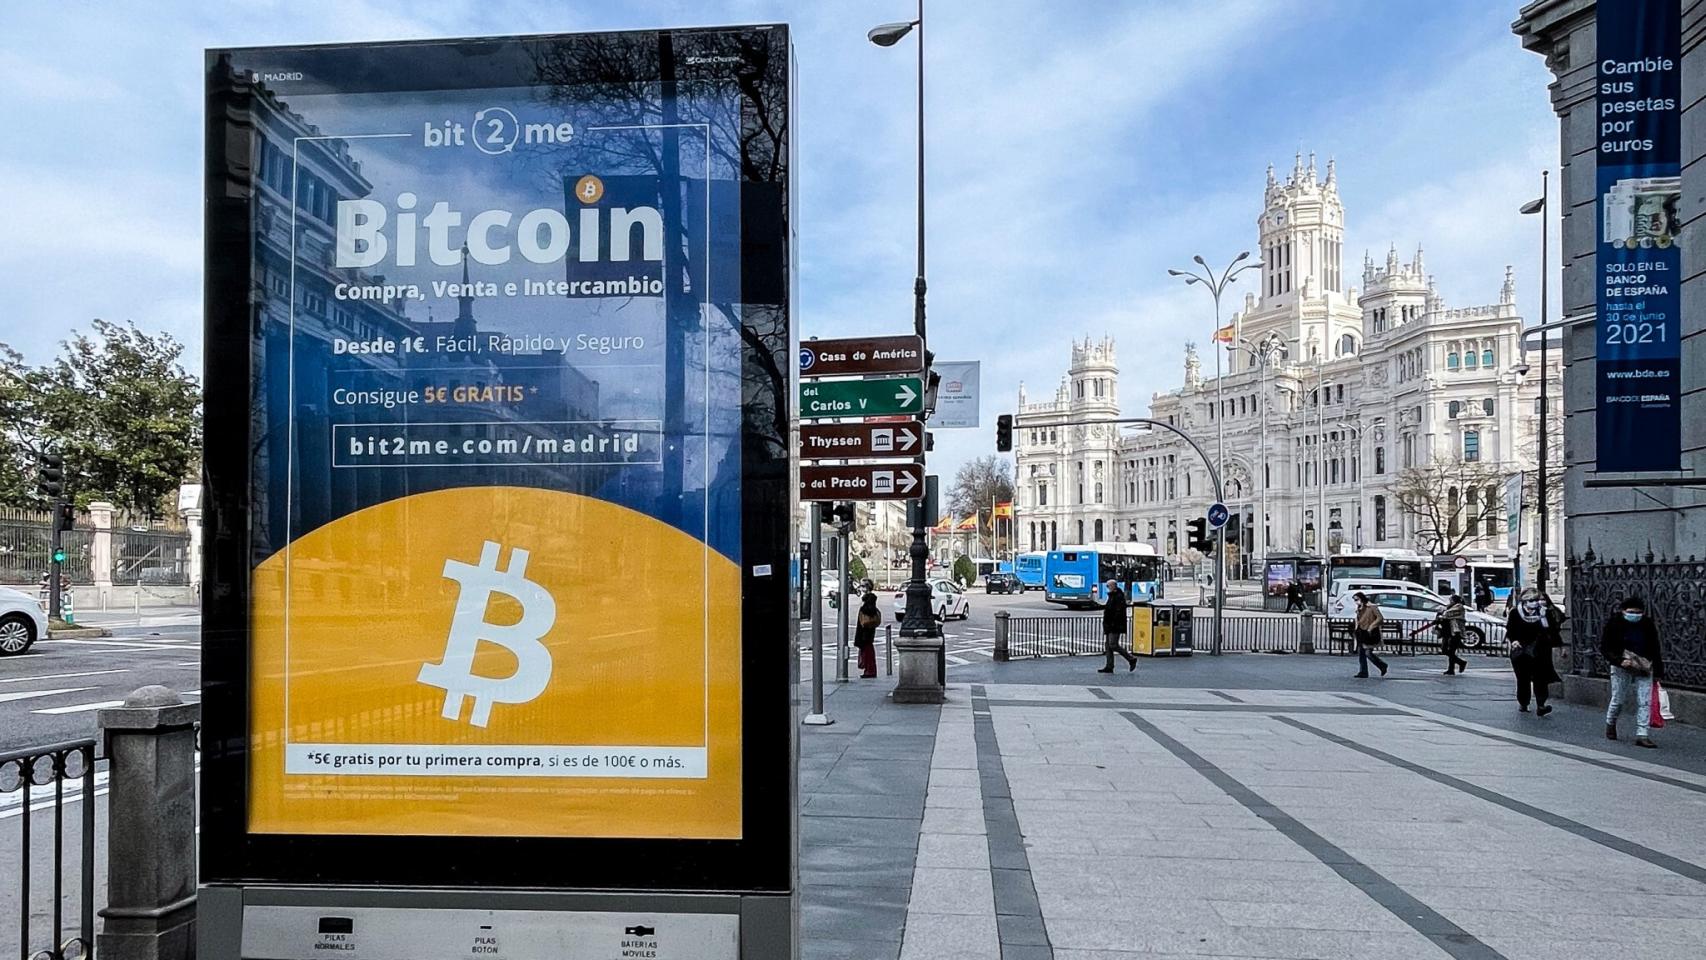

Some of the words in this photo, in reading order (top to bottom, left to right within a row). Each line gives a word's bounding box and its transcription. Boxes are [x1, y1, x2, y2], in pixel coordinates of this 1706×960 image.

[1601, 56, 1673, 75] Cambie
[264, 72, 303, 81] MADRID
[1601, 81, 1634, 94] sus
[1601, 97, 1675, 117] pesetas
[1601, 120, 1635, 136] por
[1601, 138, 1653, 153] euros
[336, 176, 663, 268] Bitcoin
[1606, 263, 1635, 272] SOLO
[1638, 262, 1654, 271] EN
[1655, 261, 1669, 271] EL
[1606, 274, 1647, 285] BANCO
[334, 283, 425, 304] Compra,
[432, 280, 498, 298] Venta
[504, 284, 517, 297] e
[524, 276, 663, 297] Intercambio
[1606, 287, 1622, 297] DE
[1624, 284, 1668, 296] ESPAÑA
[1606, 303, 1634, 311] hasta
[1635, 301, 1645, 310] el
[1606, 312, 1620, 322] 30
[1622, 312, 1636, 321] de
[1639, 312, 1666, 323] junio
[1606, 322, 1666, 344] 2021
[334, 337, 396, 354] Desde
[401, 337, 430, 354] 1€.
[436, 335, 481, 355] Fácil,
[489, 334, 557, 356] Rápido
[559, 337, 571, 355] y
[576, 334, 644, 355] Seguro
[819, 352, 846, 362] Casa
[852, 351, 866, 361] de
[872, 349, 917, 360] América
[1607, 369, 1670, 379] www.bde.es
[334, 387, 419, 409] Consigue
[424, 387, 447, 403] 5€
[453, 386, 524, 403] GRATIS
[803, 388, 819, 396] del
[810, 400, 851, 412] Carlos
[859, 398, 867, 409] V
[350, 433, 639, 456] bit2me.com/madrid
[809, 436, 861, 449] Thyssen
[811, 479, 826, 489] del
[831, 475, 867, 488] Prado
[334, 753, 374, 767] gratis
[378, 755, 402, 768] por
[406, 755, 420, 766] tu
[425, 754, 482, 769] primera
[487, 756, 544, 769] compra,
[549, 755, 559, 767] si
[563, 757, 578, 767] es
[582, 755, 599, 767] de
[604, 755, 636, 767] 100€
[640, 758, 648, 768] o
[653, 756, 685, 768] más.
[314, 943, 355, 951] NORMALES
